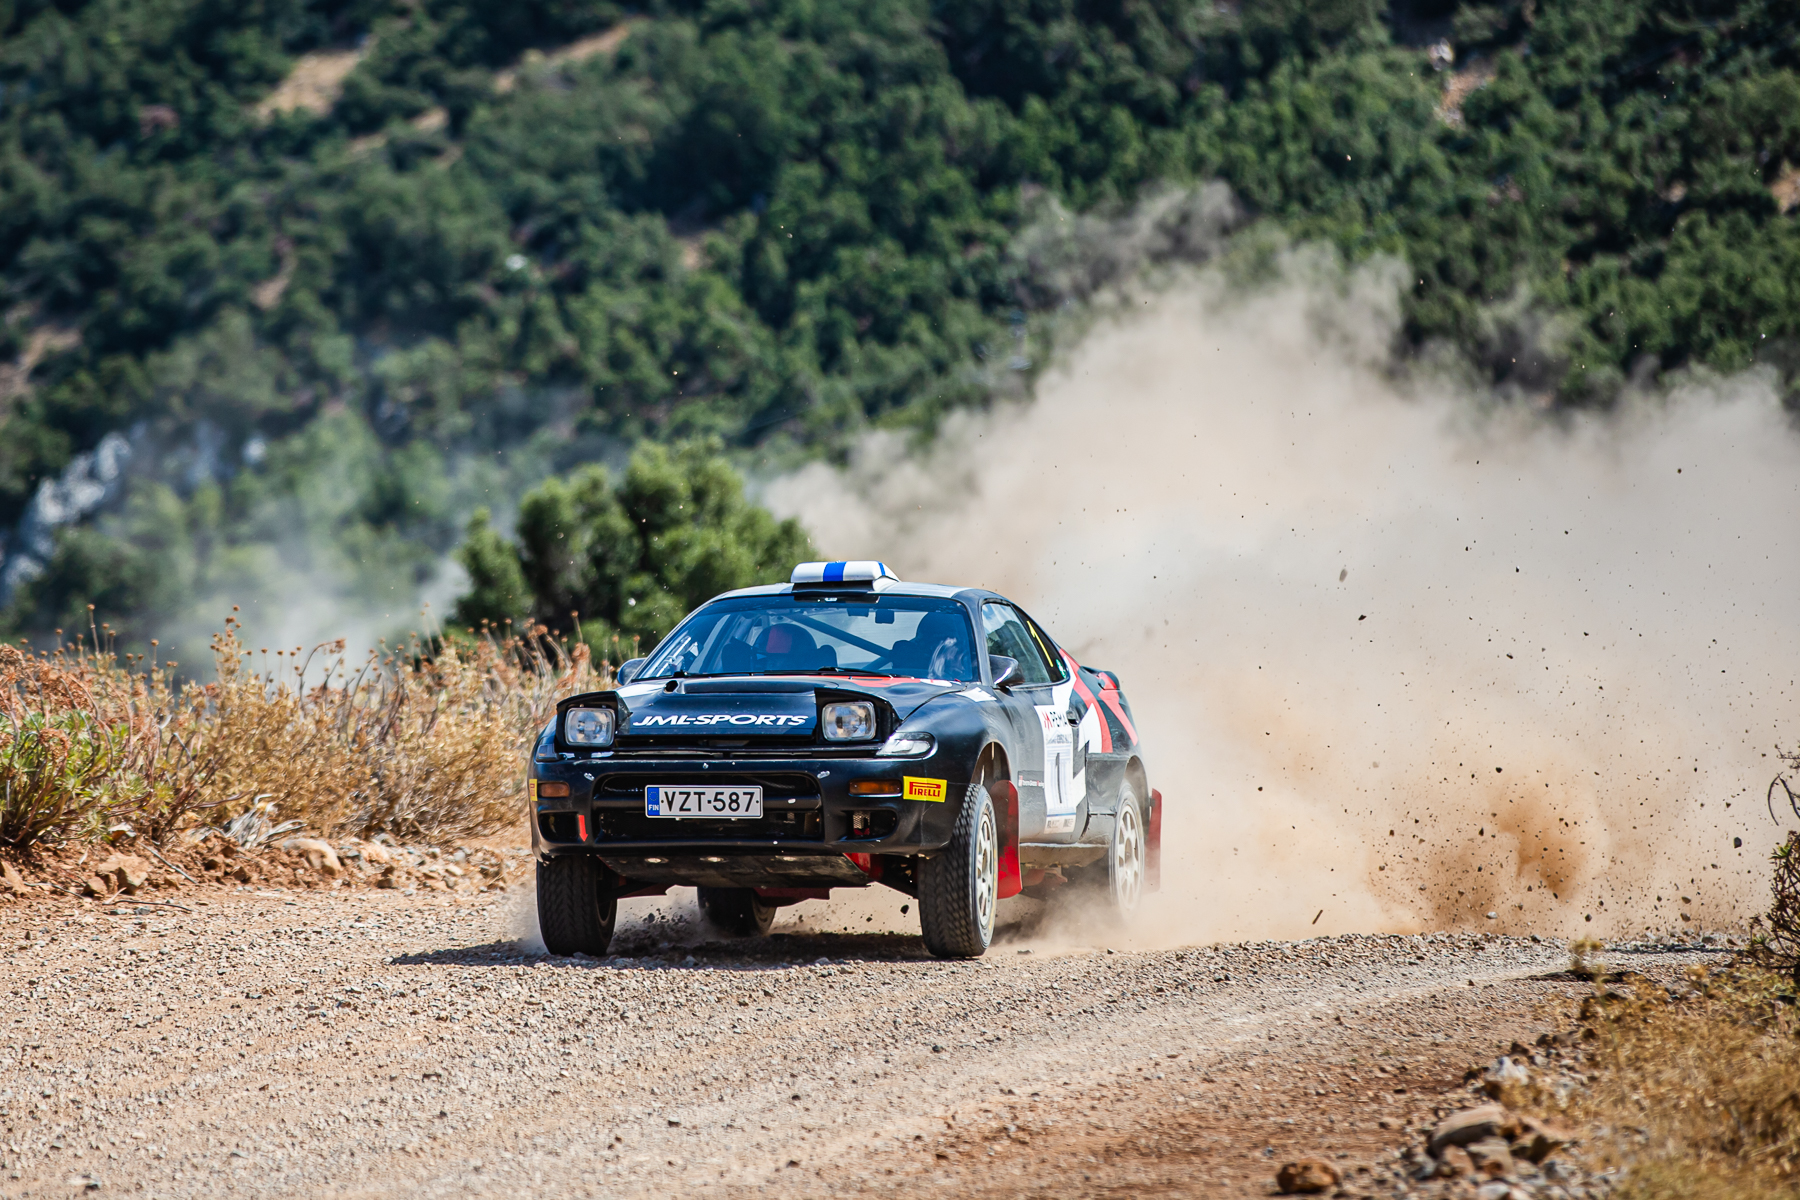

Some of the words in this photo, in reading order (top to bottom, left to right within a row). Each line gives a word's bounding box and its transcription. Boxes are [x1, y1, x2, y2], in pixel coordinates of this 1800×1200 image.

[632, 714, 809, 726] JML-SPORTS
[909, 781, 941, 797] PIRELLI
[664, 791, 755, 812] VZT-587
